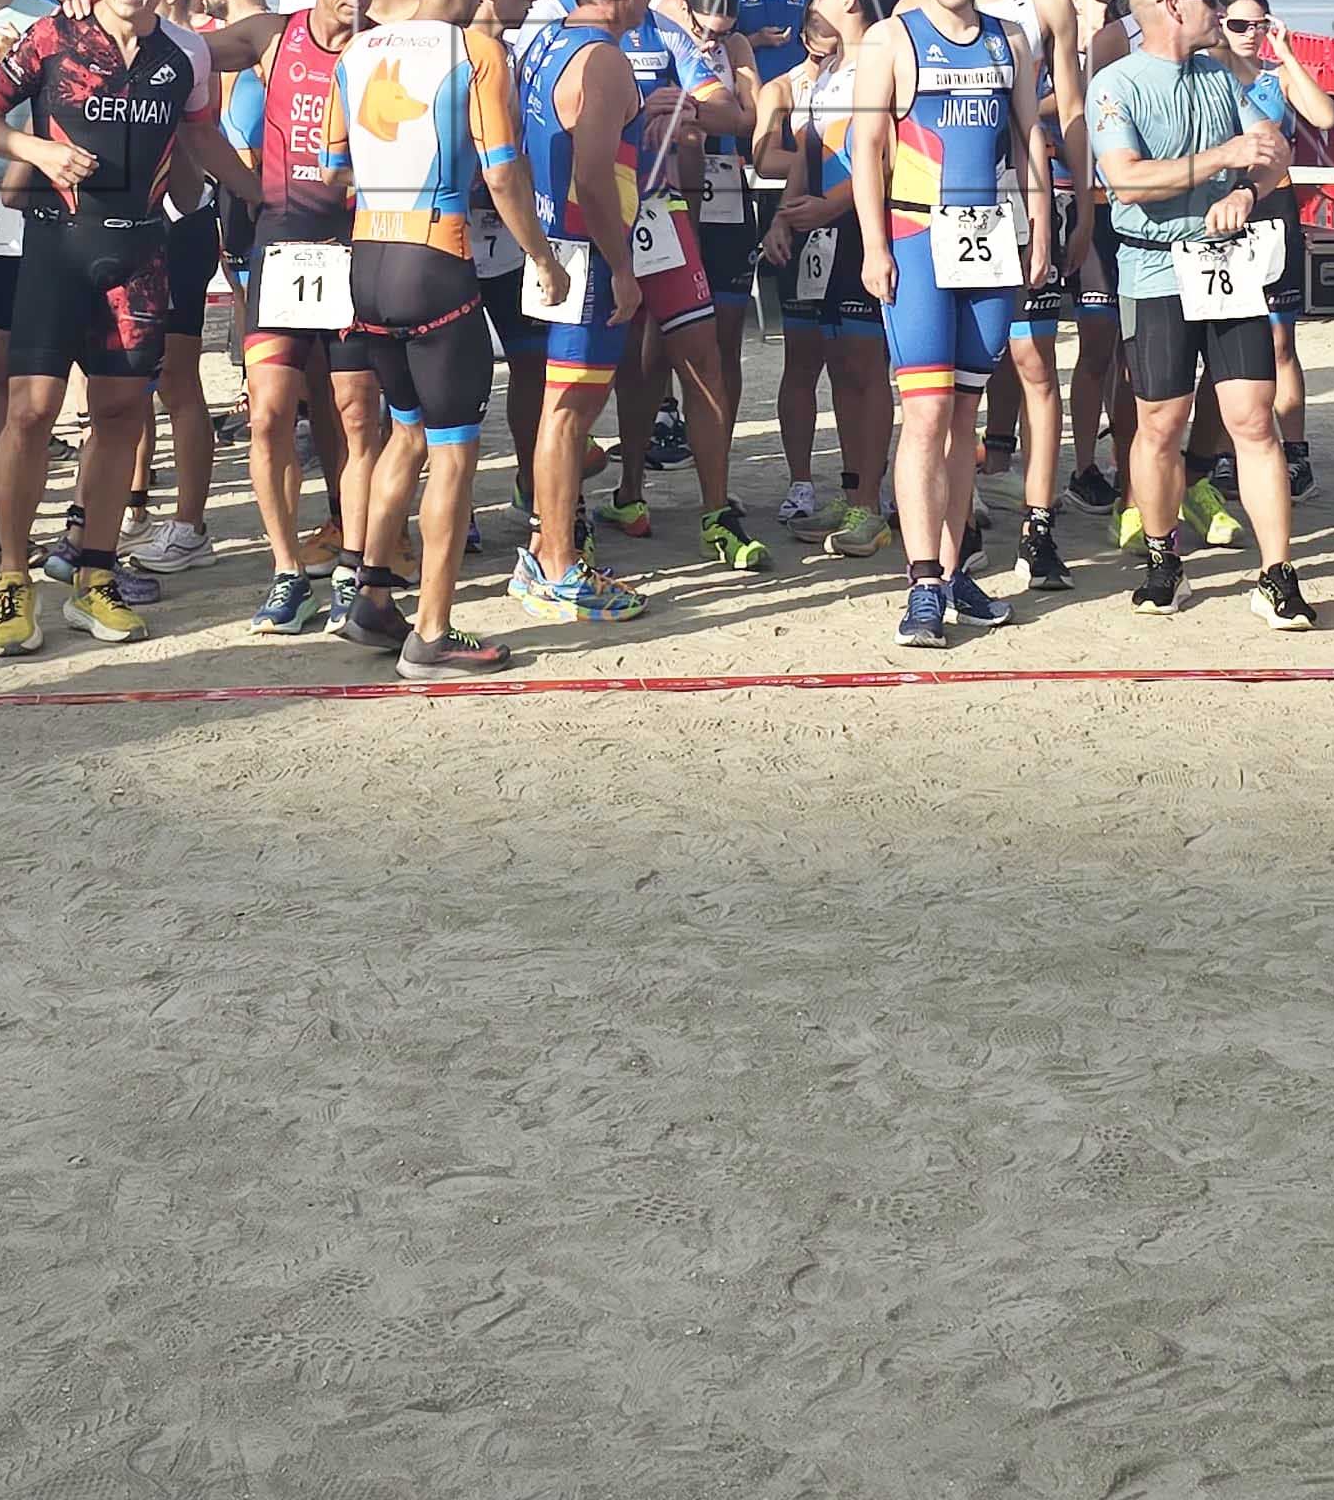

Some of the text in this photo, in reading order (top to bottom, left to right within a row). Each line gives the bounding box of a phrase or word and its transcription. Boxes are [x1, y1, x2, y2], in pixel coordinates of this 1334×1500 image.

[84, 95, 172, 125] GERMAN
[937, 99, 1000, 128] JIMENO
[483, 235, 498, 258] 7
[635, 226, 654, 252] 9
[958, 236, 992, 262] 25
[806, 254, 822, 279] 13
[292, 275, 323, 302] 11
[1200, 269, 1234, 295] 78
